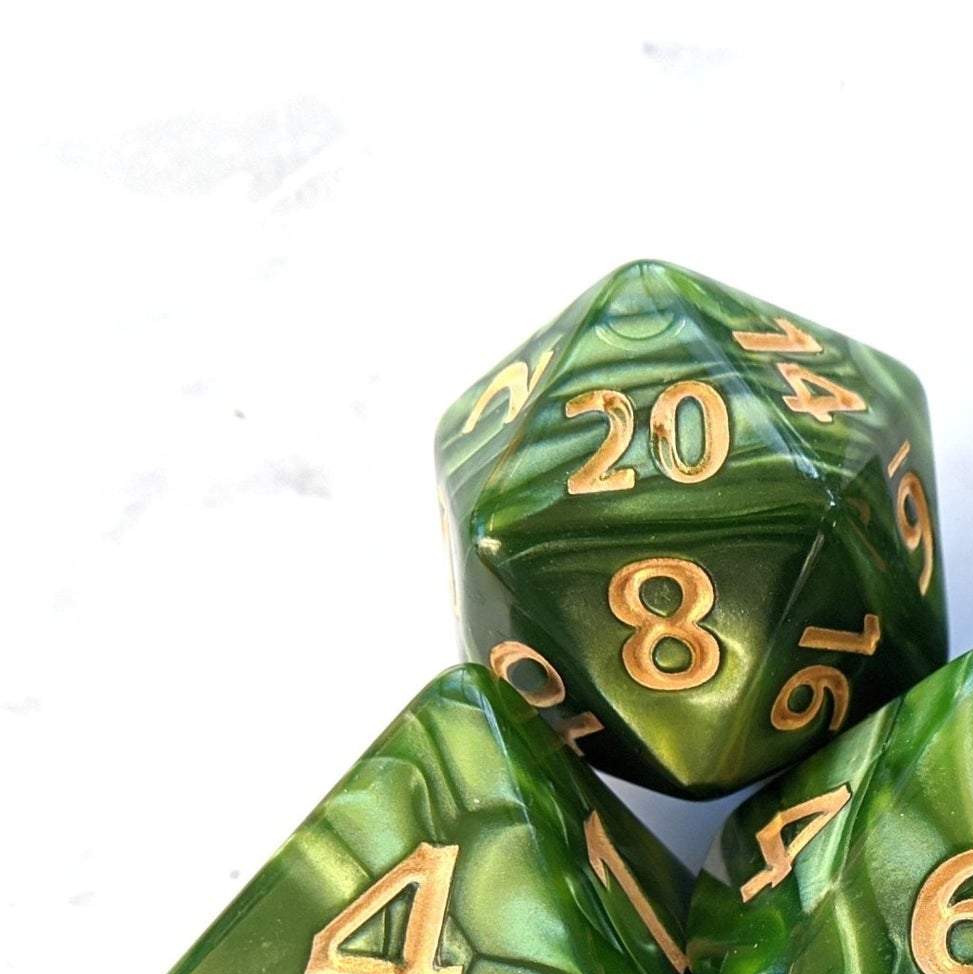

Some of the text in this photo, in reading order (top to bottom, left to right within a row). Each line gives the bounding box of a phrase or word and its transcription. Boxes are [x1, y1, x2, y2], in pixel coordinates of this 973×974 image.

[733, 318, 868, 423] 14
[565, 379, 730, 495] 20
[608, 558, 721, 691] 8
[771, 614, 880, 732] 16
[741, 784, 851, 902] 4
